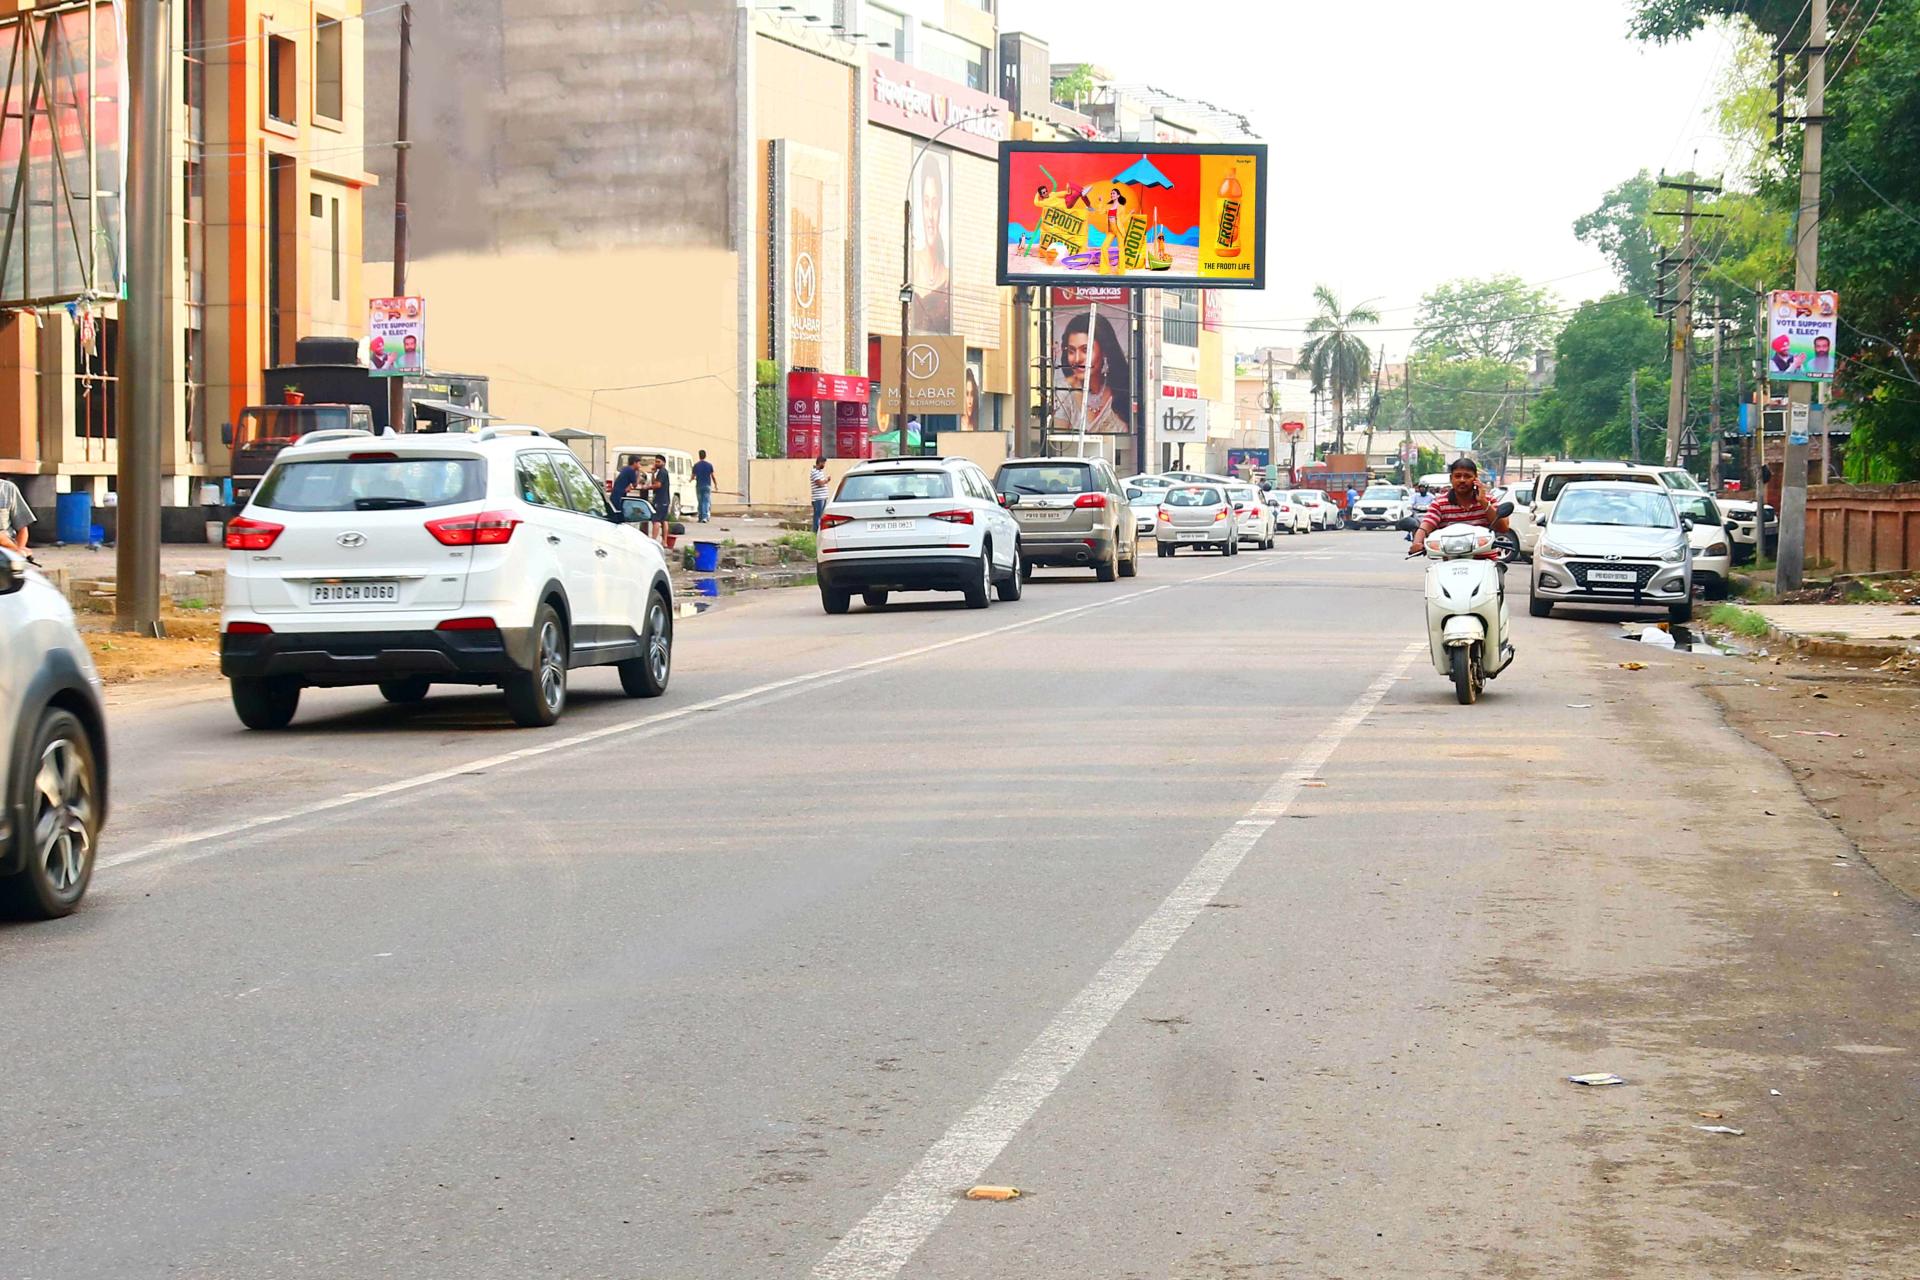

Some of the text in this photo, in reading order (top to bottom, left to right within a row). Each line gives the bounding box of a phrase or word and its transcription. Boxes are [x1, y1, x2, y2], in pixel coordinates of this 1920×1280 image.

[1045, 208, 1083, 235] FROOTI
[1219, 200, 1240, 248] FROOTI
[1125, 217, 1147, 267] FROOTI
[1204, 262, 1215, 270] THE
[1216, 262, 1237, 270] FROOTI
[1776, 319, 1832, 328] VOTE SUPPORT
[888, 387, 956, 398] MLABAR
[363, 586, 394, 599] 0060
